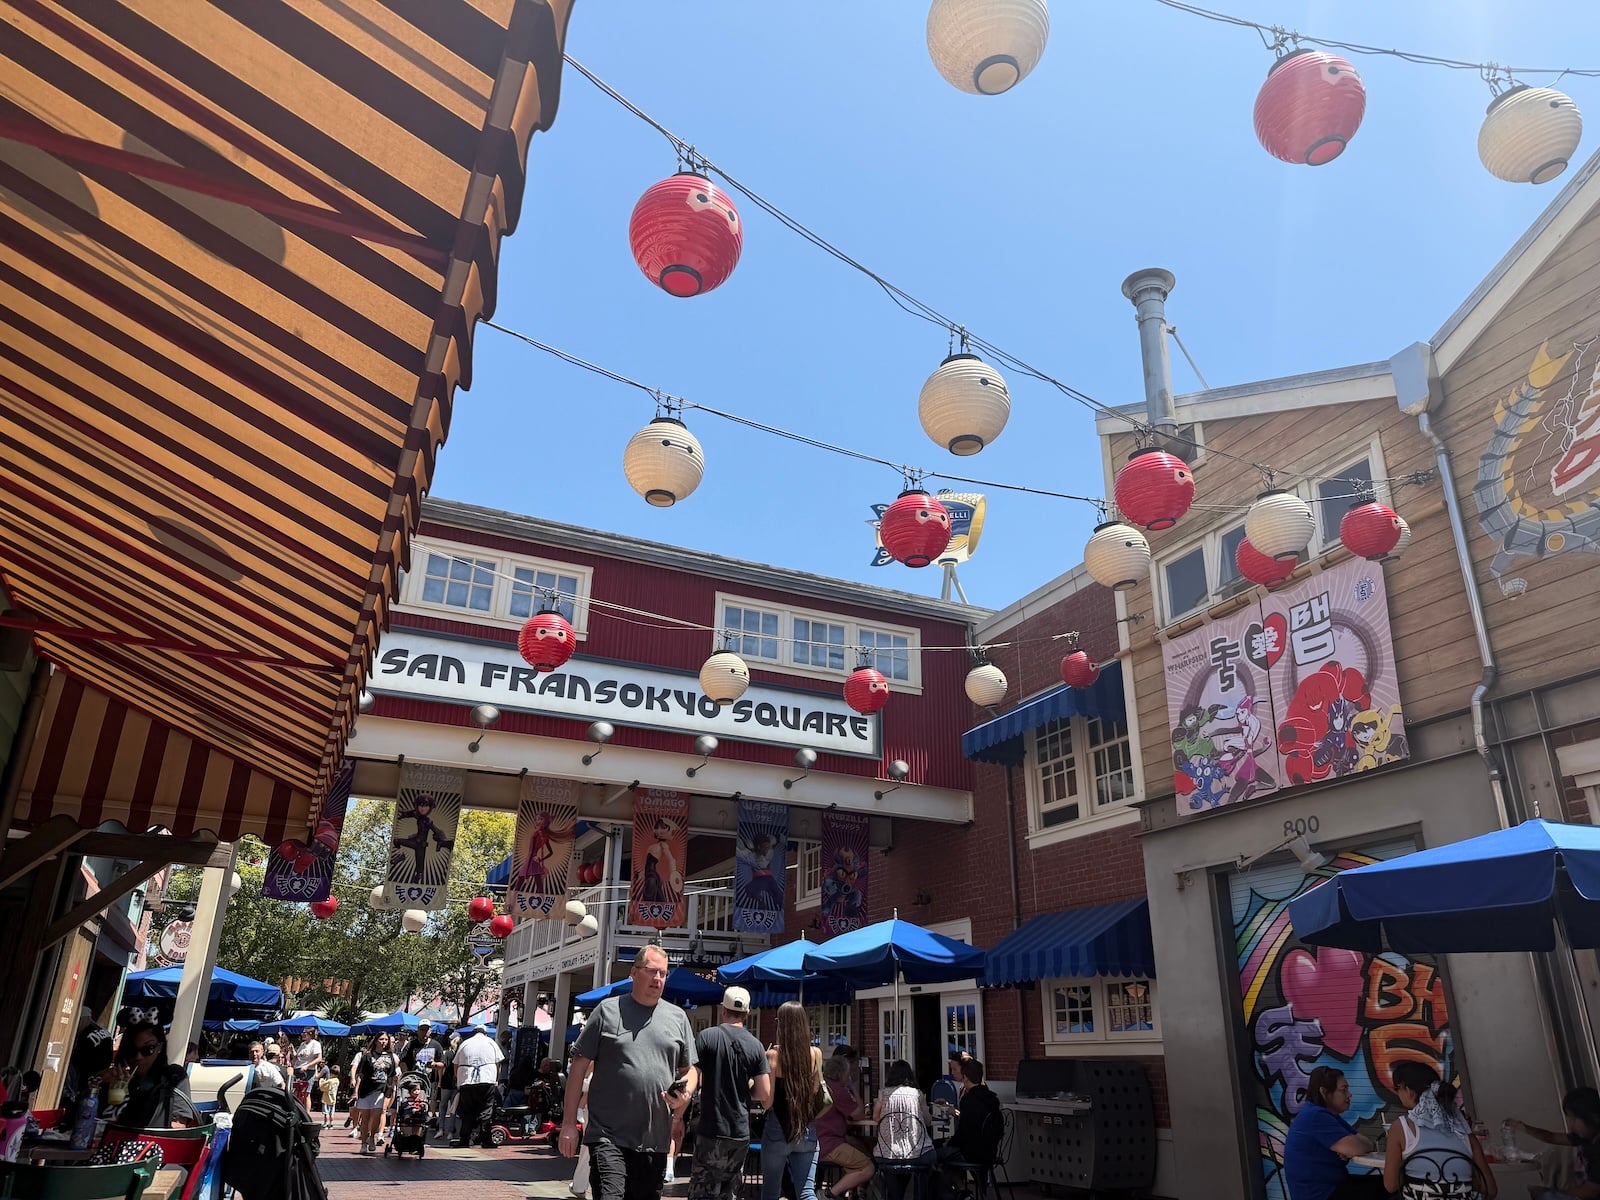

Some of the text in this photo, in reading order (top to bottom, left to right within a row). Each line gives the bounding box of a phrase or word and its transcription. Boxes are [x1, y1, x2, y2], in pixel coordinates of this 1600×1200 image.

[380, 648, 868, 741] SAN FRANSOKYO SQUARE
[1283, 815, 1320, 838] 800
[1365, 955, 1450, 1030] BH
